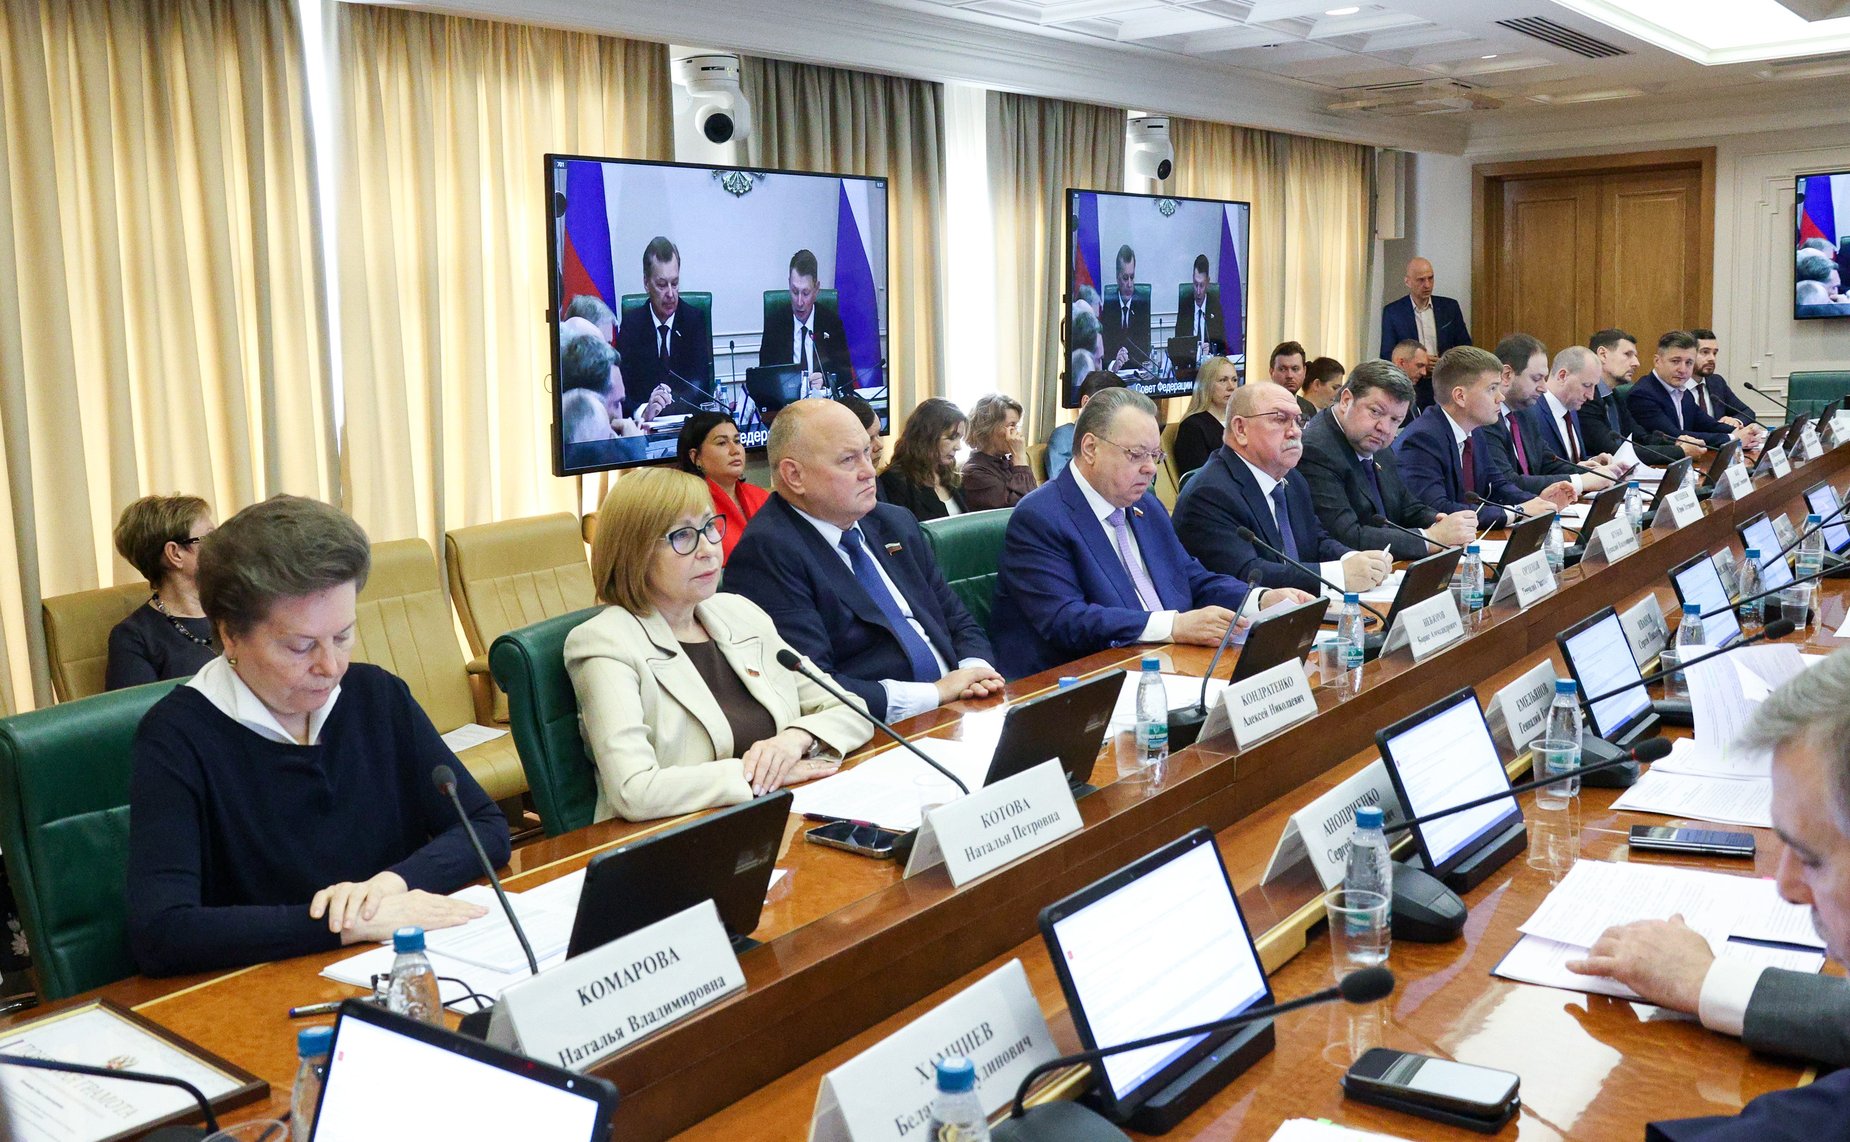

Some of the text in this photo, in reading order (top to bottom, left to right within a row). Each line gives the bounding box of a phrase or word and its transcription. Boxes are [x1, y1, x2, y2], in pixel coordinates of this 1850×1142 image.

[1135, 381, 1193, 394] Совет Федерации
[1241, 676, 1294, 707] КОНДРАТЕНКО
[1516, 682, 1549, 712] ЕМЕЛЬЯНОВ
[1243, 694, 1305, 727] Алексей Николаевич
[1519, 711, 1541, 734] Геннадий
[980, 797, 1031, 829] КОТОВА
[964, 810, 1061, 862] Наталья Петровна
[577, 946, 681, 1007] КОМАРОВА
[557, 976, 726, 1068] Наталья Владимировна
[895, 1101, 934, 1136] Бела
